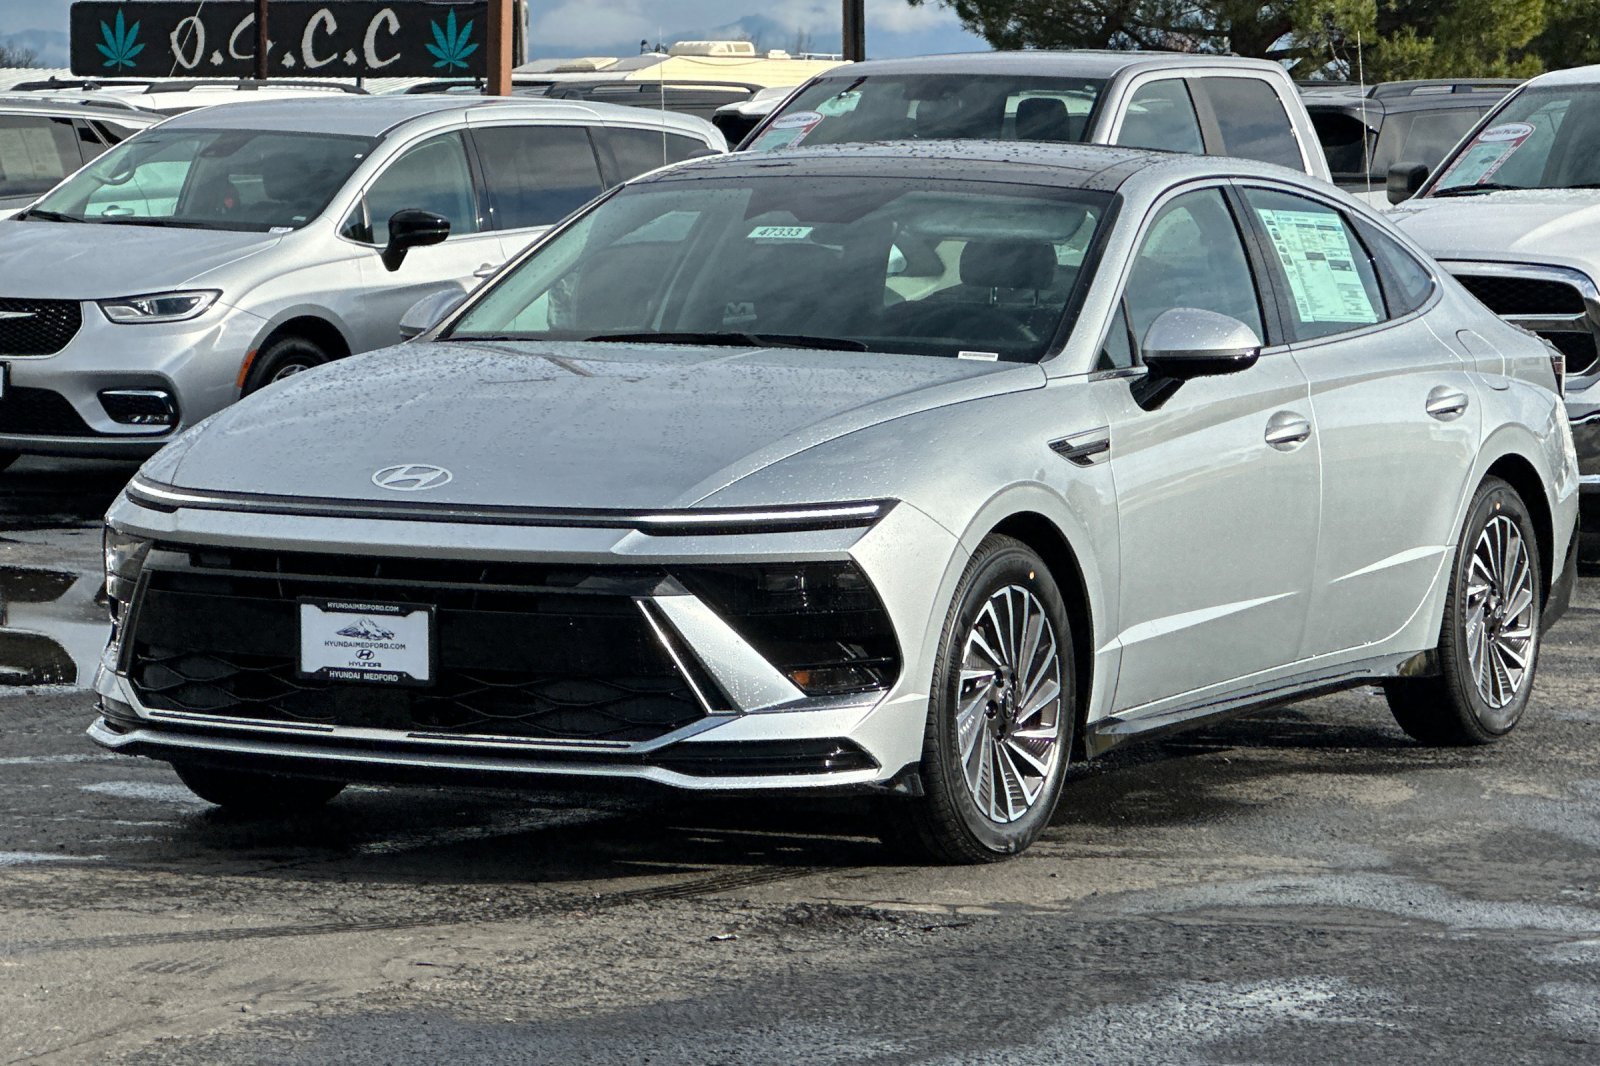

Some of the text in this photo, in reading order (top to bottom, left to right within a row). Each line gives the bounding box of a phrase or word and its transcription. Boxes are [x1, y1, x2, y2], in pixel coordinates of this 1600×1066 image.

[758, 227, 802, 237] 47333
[327, 601, 400, 612] HYUNDAIMEDFORD.COM
[324, 640, 406, 650] HYUNDAIMEDFORD.COM
[348, 660, 382, 668] HYUNDAI
[329, 670, 399, 682] HYUNDAI MEDFORD
